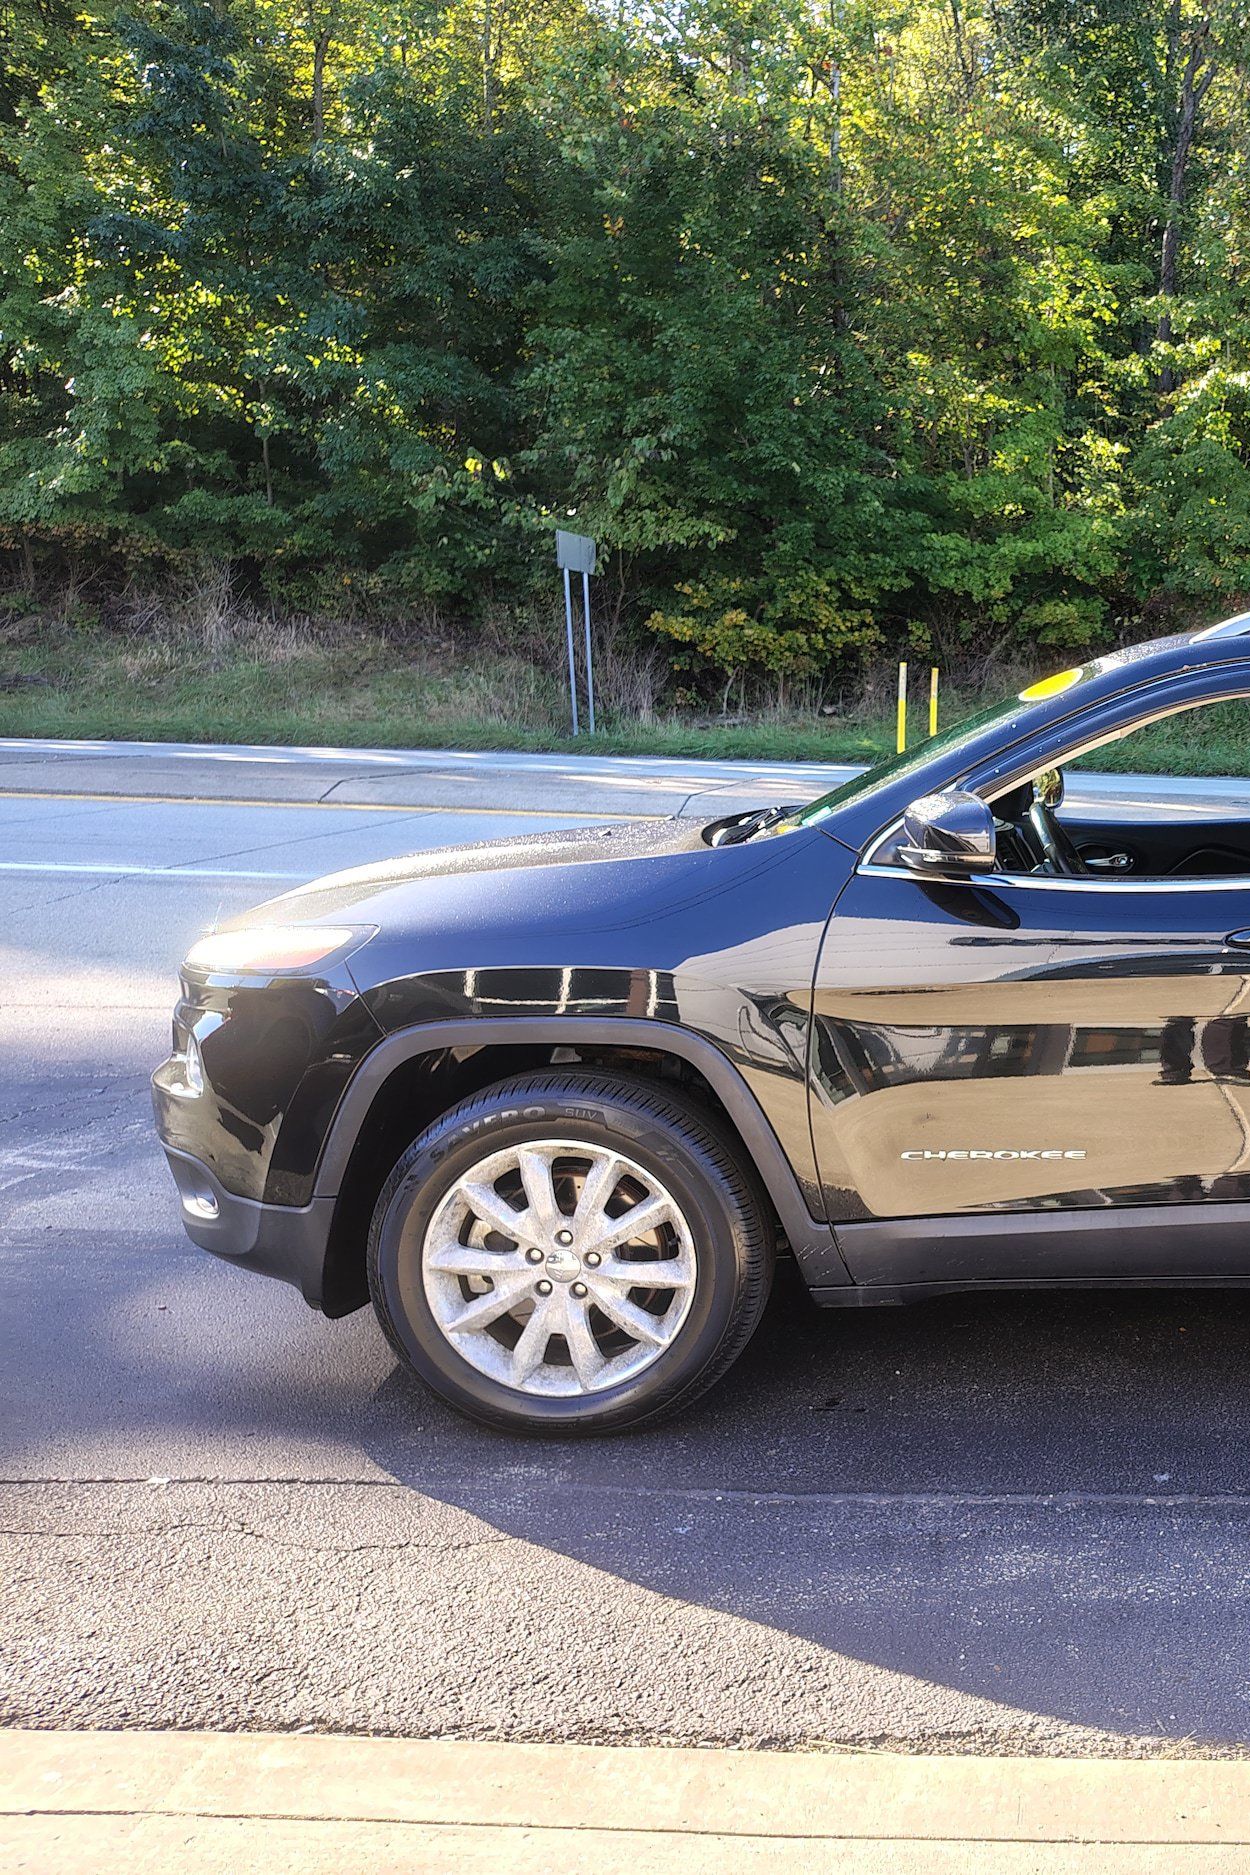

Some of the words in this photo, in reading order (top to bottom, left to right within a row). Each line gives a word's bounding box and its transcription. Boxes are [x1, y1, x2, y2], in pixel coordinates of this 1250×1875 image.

[429, 1106, 546, 1163] SAVERO
[564, 1107, 598, 1121] SUV
[900, 1150, 1087, 1161] CHEROKEE
